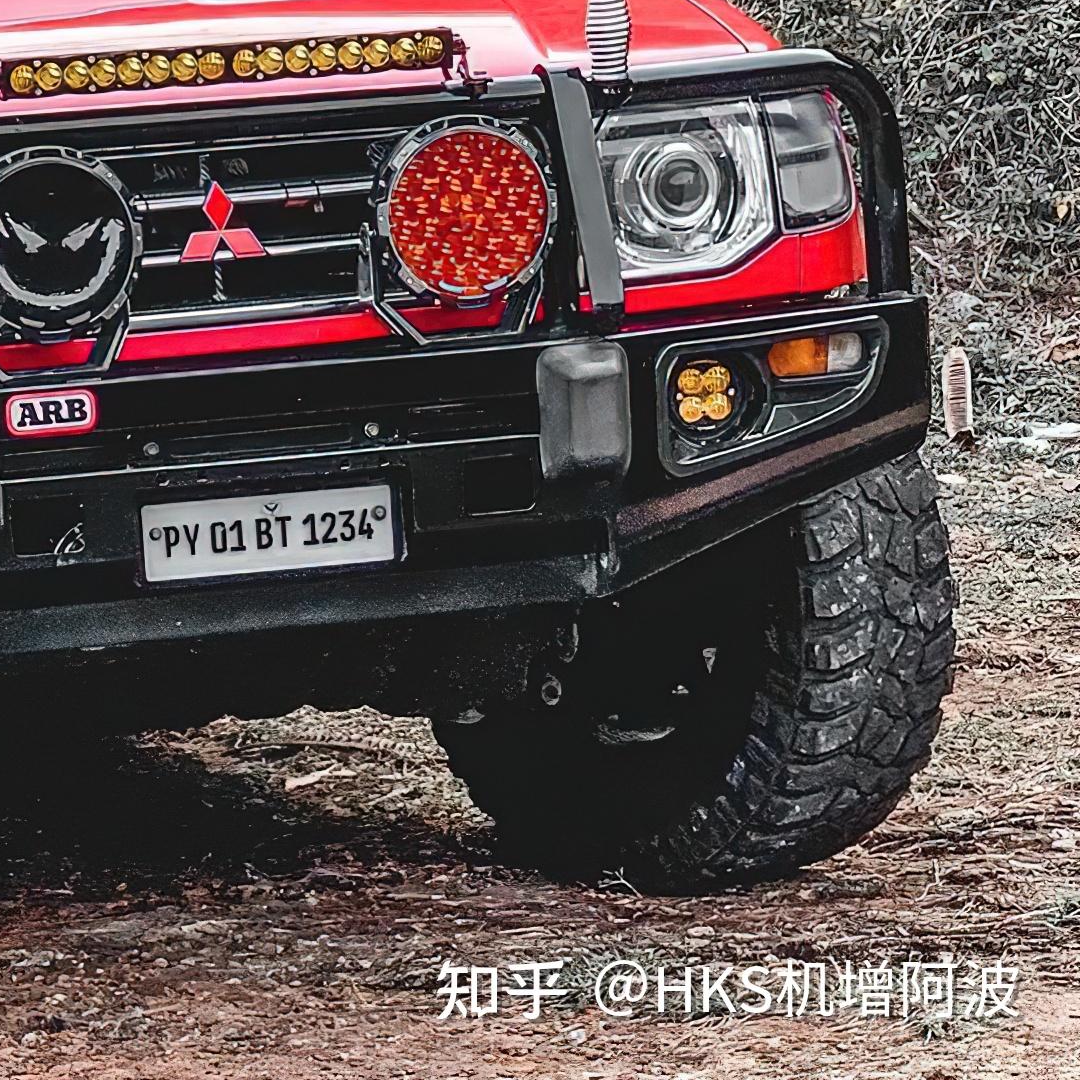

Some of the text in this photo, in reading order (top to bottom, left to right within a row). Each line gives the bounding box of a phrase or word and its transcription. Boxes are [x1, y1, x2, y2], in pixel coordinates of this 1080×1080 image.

[17, 398, 88, 427] ARB
[162, 508, 374, 558] PY 01 BT 1234
